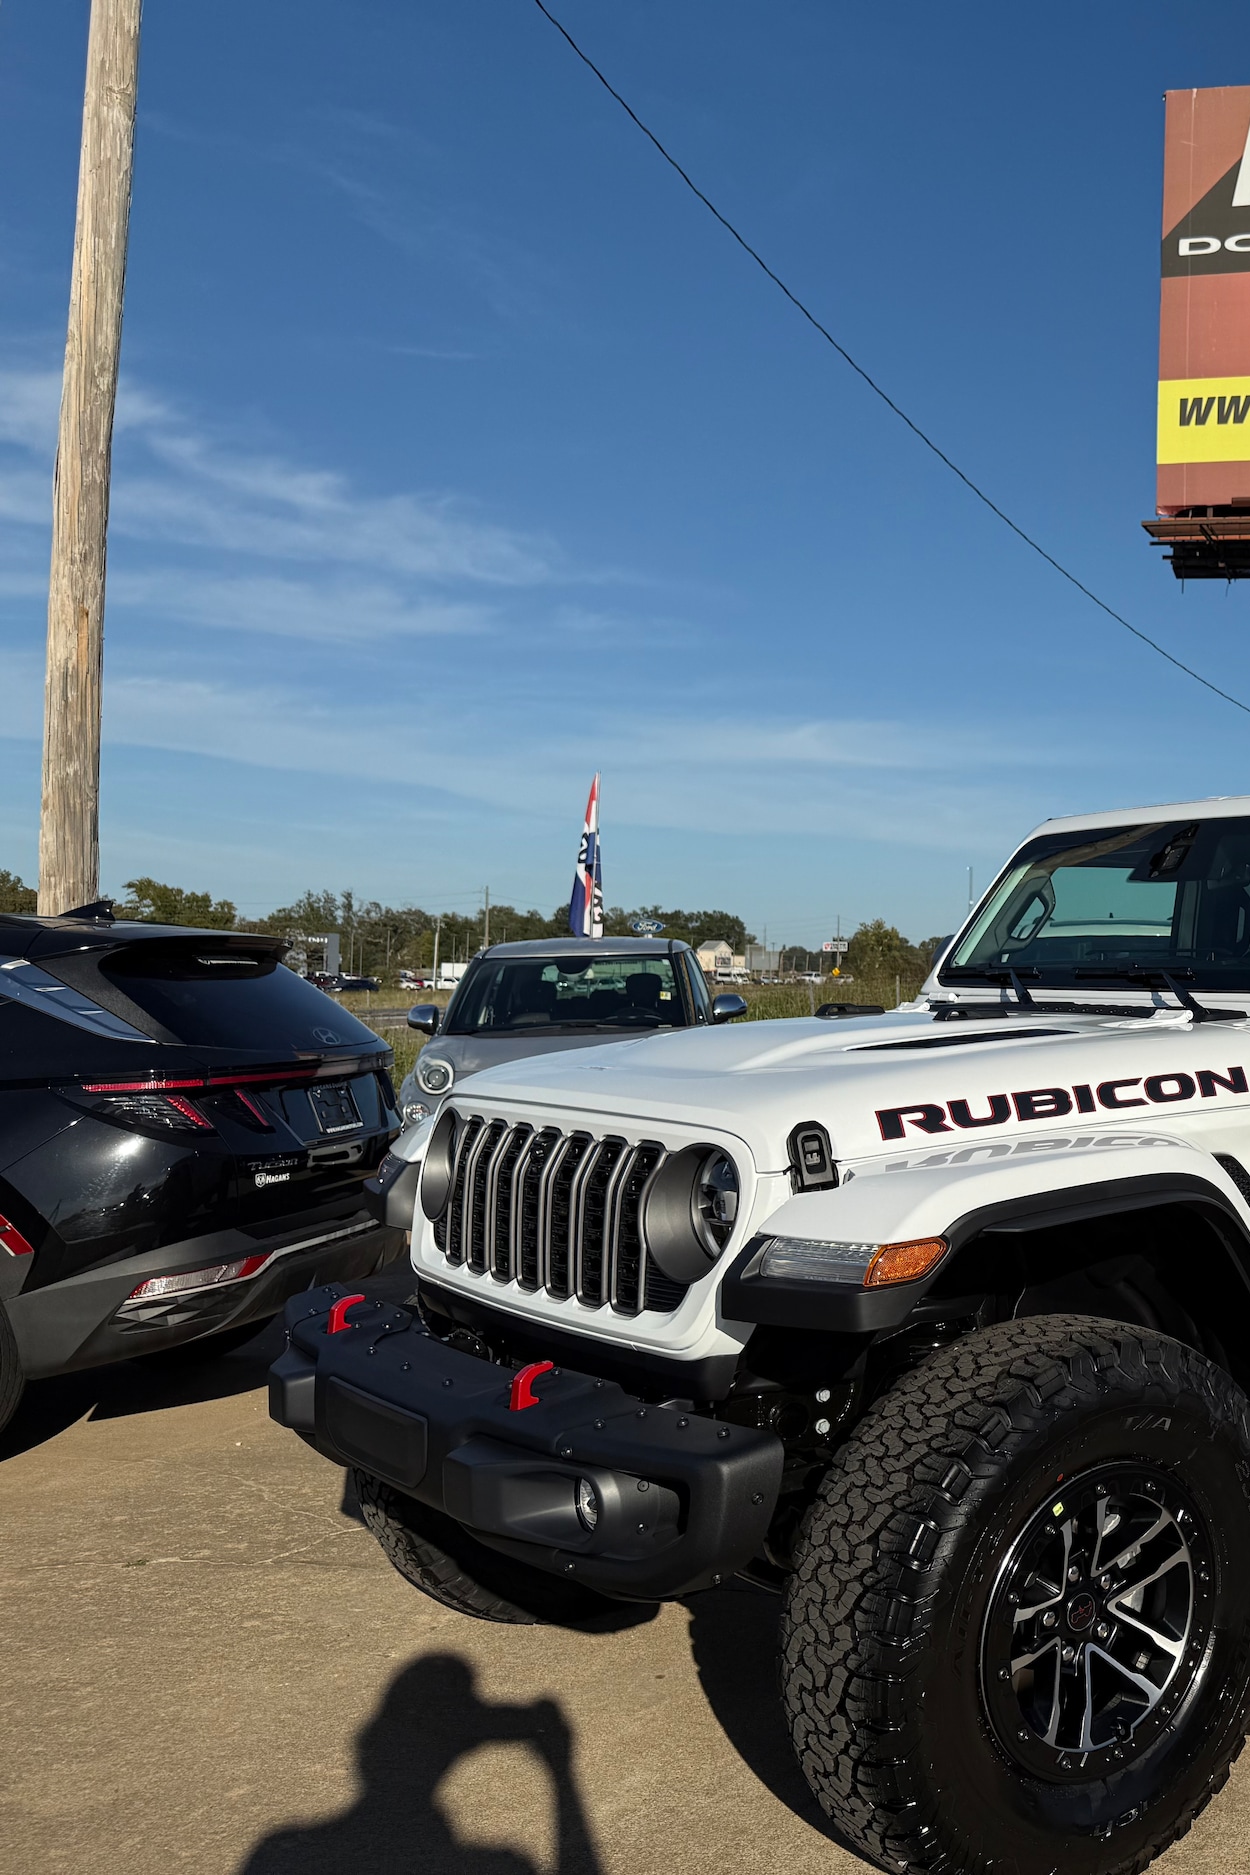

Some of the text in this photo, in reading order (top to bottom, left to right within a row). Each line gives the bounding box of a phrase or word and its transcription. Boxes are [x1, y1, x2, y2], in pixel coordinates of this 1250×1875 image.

[637, 921, 659, 931] Ford
[874, 1066, 1249, 1141] RUBICON
[266, 1172, 290, 1185] HAGANS
